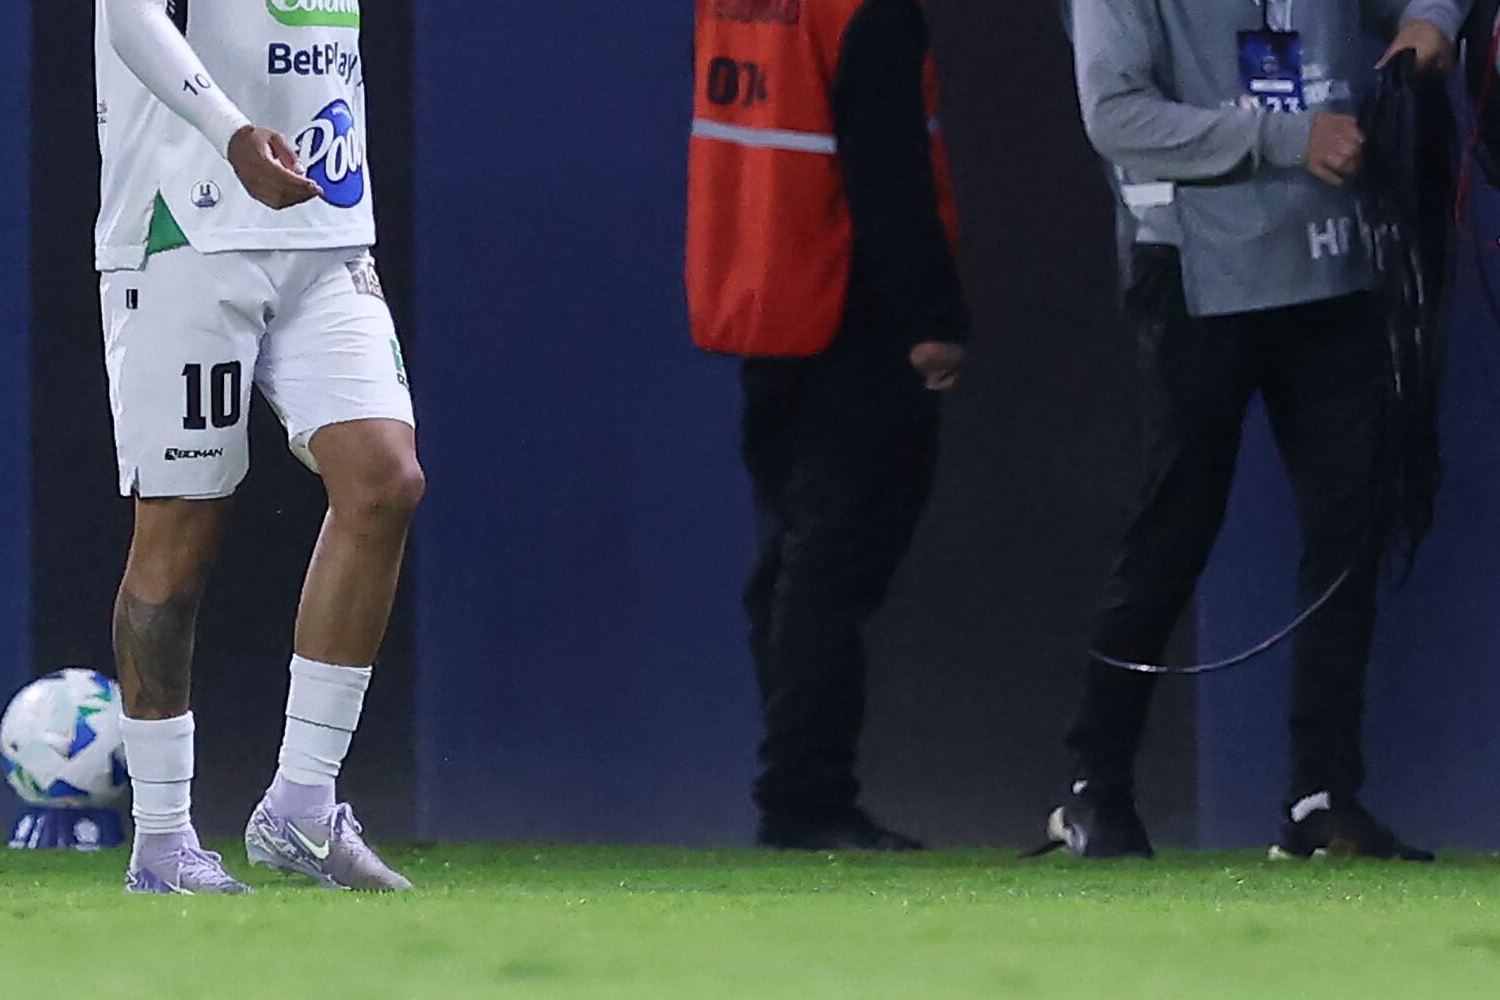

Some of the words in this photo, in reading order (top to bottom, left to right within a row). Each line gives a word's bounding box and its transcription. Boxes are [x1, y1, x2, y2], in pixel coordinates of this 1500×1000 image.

[183, 73, 211, 95] 10
[268, 42, 358, 85] BetPlay
[181, 360, 242, 430] 10
